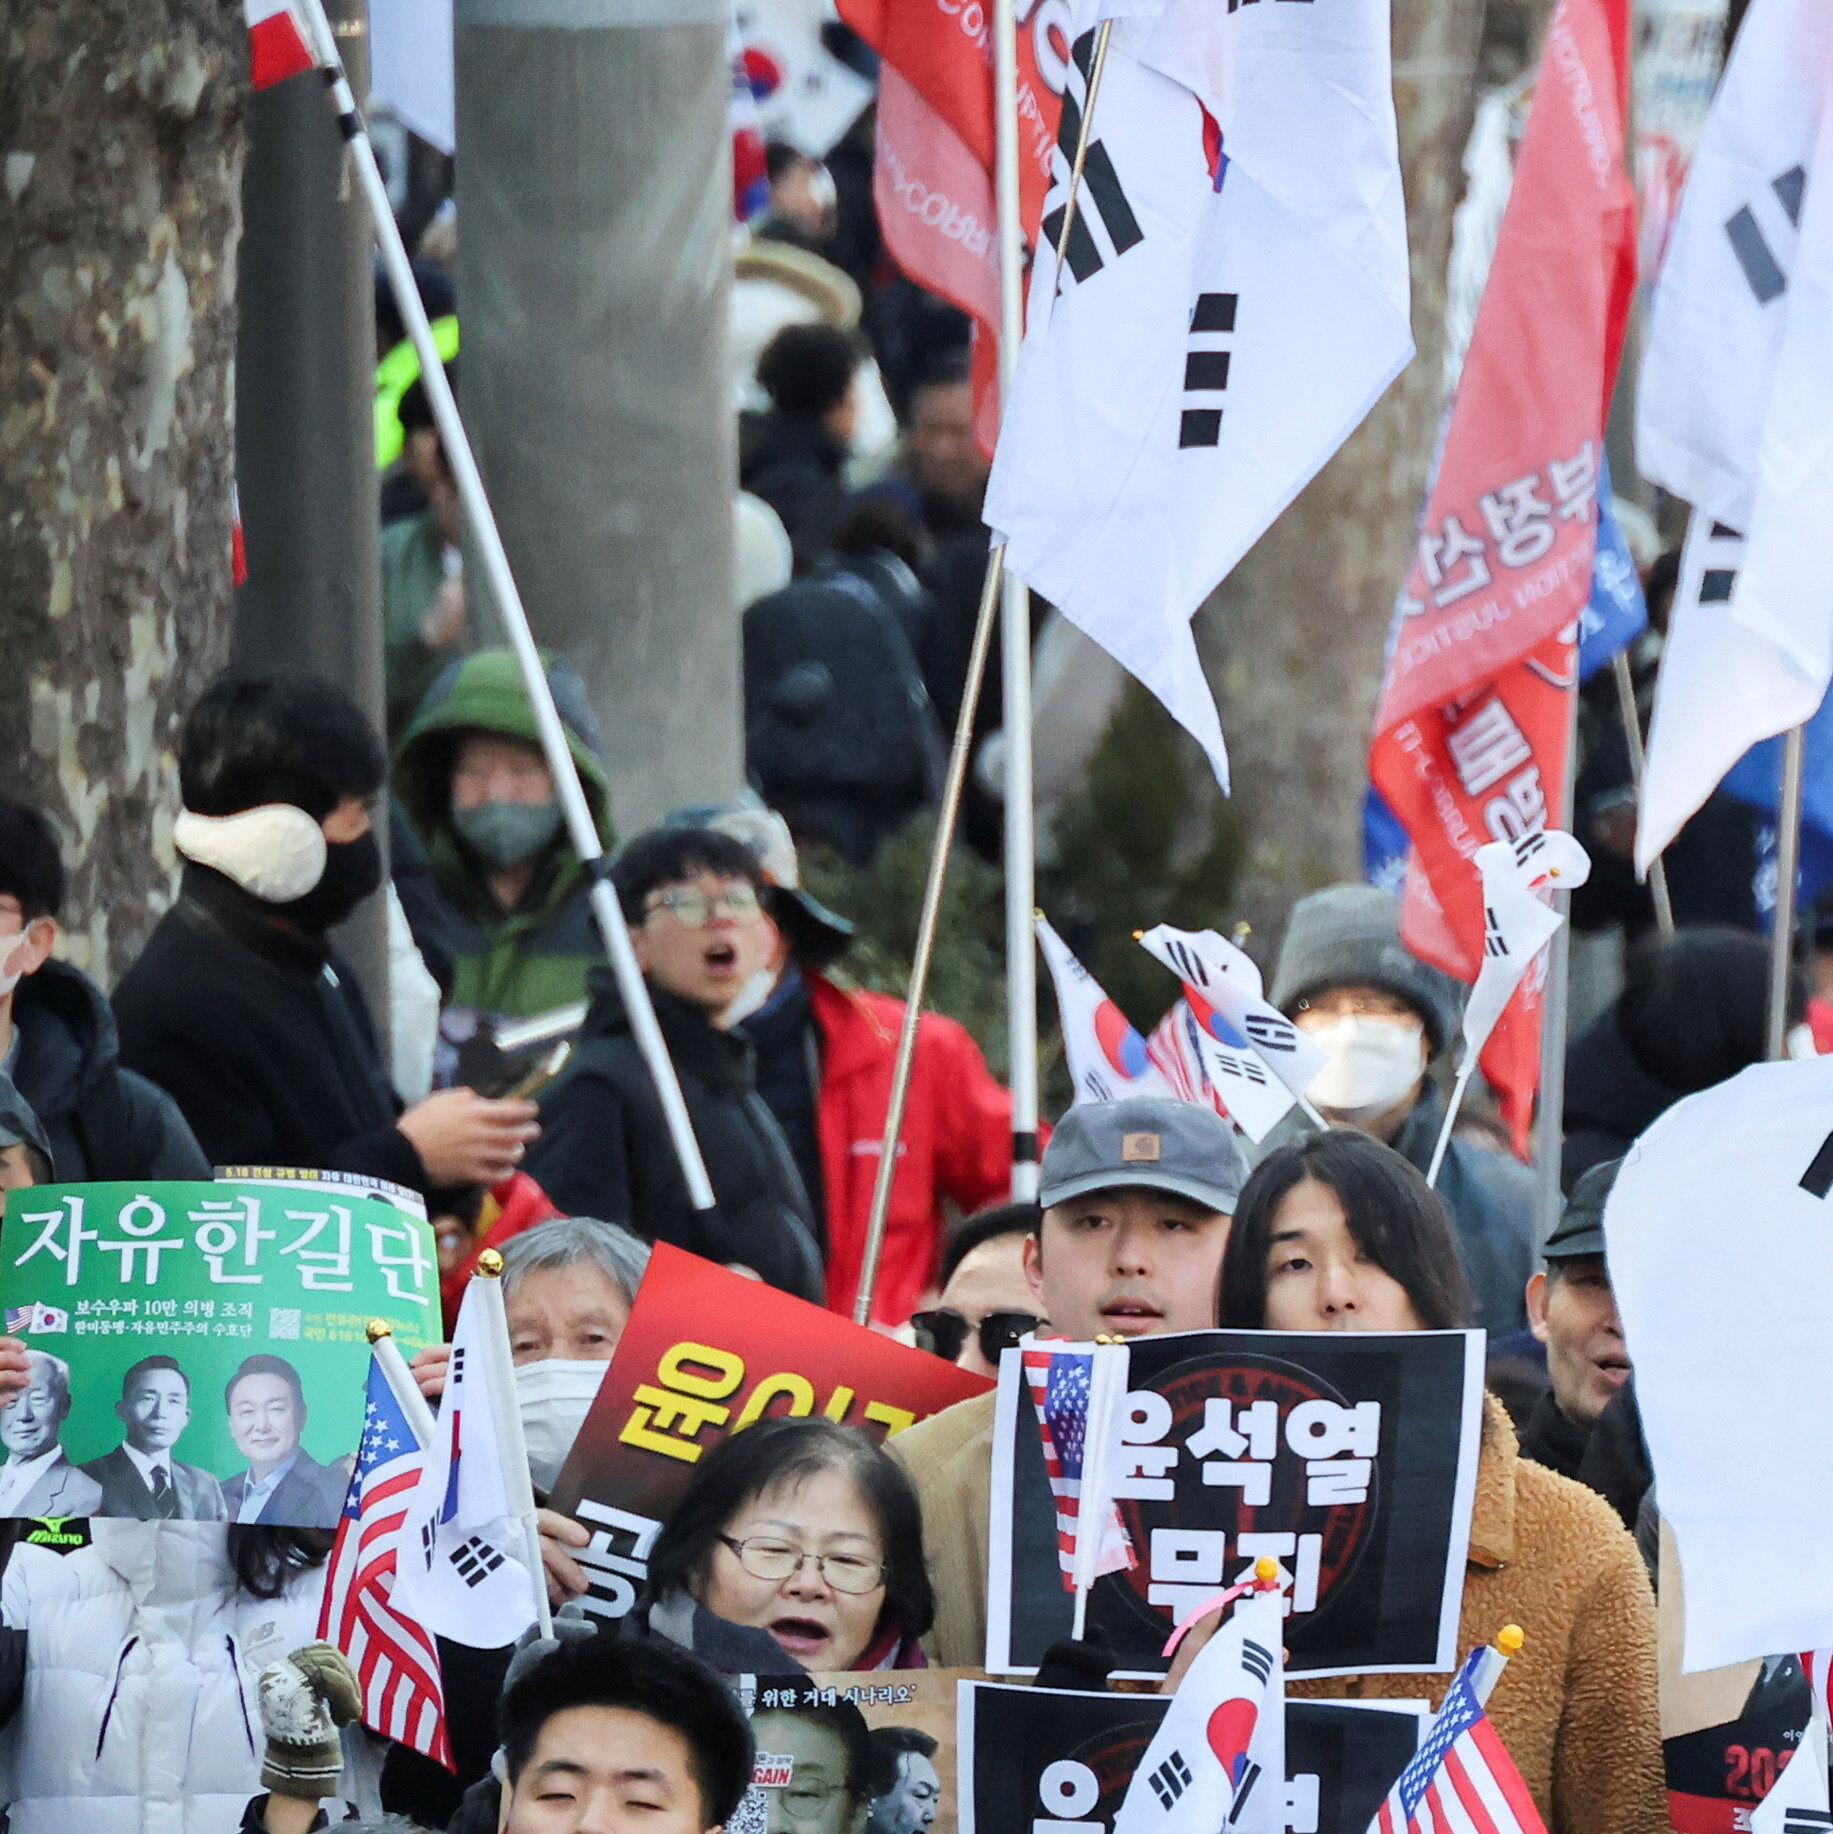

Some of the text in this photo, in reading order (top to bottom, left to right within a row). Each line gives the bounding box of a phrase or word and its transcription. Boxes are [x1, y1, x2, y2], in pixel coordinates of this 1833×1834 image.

[13, 1194, 434, 1308] 자유한길단
[74, 1298, 139, 1317] 보수우파
[143, 1299, 179, 1318] 10만
[1111, 1389, 1382, 1507] 윤석열
[761, 1687, 798, 1708] 위한
[803, 1686, 837, 1708] 거대
[752, 1766, 792, 1786] GAIN
